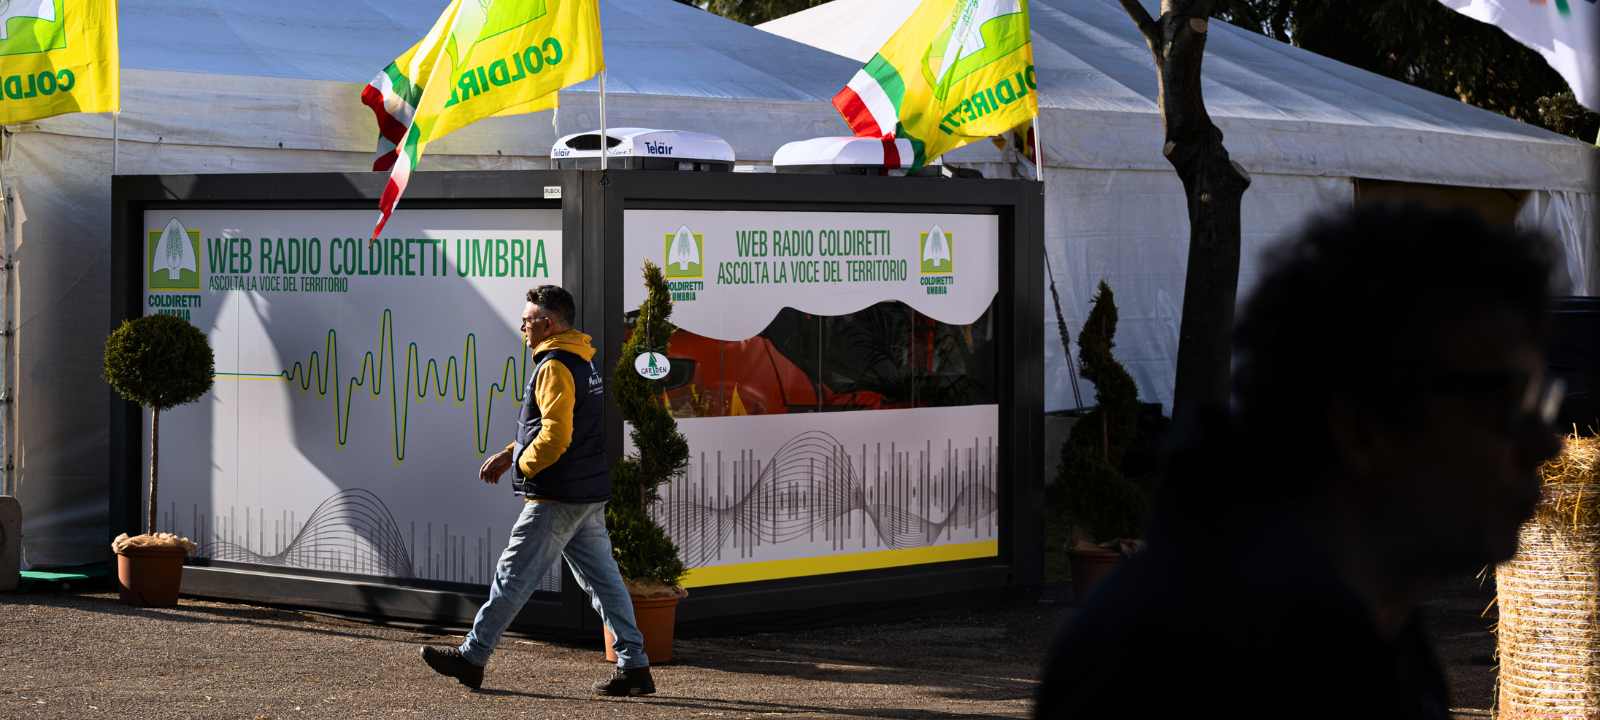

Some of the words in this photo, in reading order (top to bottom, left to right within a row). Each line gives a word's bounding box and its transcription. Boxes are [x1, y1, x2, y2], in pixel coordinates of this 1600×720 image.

[736, 230, 768, 257] WEB
[773, 230, 814, 257] RADIO
[819, 229, 890, 256] COLDIRETTI
[207, 237, 252, 274] WEB
[260, 237, 321, 275] RADIO
[329, 237, 447, 277] COLDIRETTI
[456, 238, 549, 278] UMBRIA
[717, 261, 769, 285] ASCOLTA
[773, 261, 787, 283] LA
[790, 260, 820, 283] VOCE
[823, 260, 843, 282] DEL
[846, 259, 907, 282] TERRITORIO
[208, 275, 245, 291] ASCOLTA
[247, 275, 257, 291] LA
[259, 276, 281, 292] VOCE
[283, 276, 298, 292] DEL
[300, 276, 348, 293] TERRITORIO
[920, 276, 954, 286] COLDIRETTI
[672, 292, 696, 301] UMBRIA
[926, 286, 947, 295] UMBRIA
[148, 294, 202, 308] COLDIRETTI
